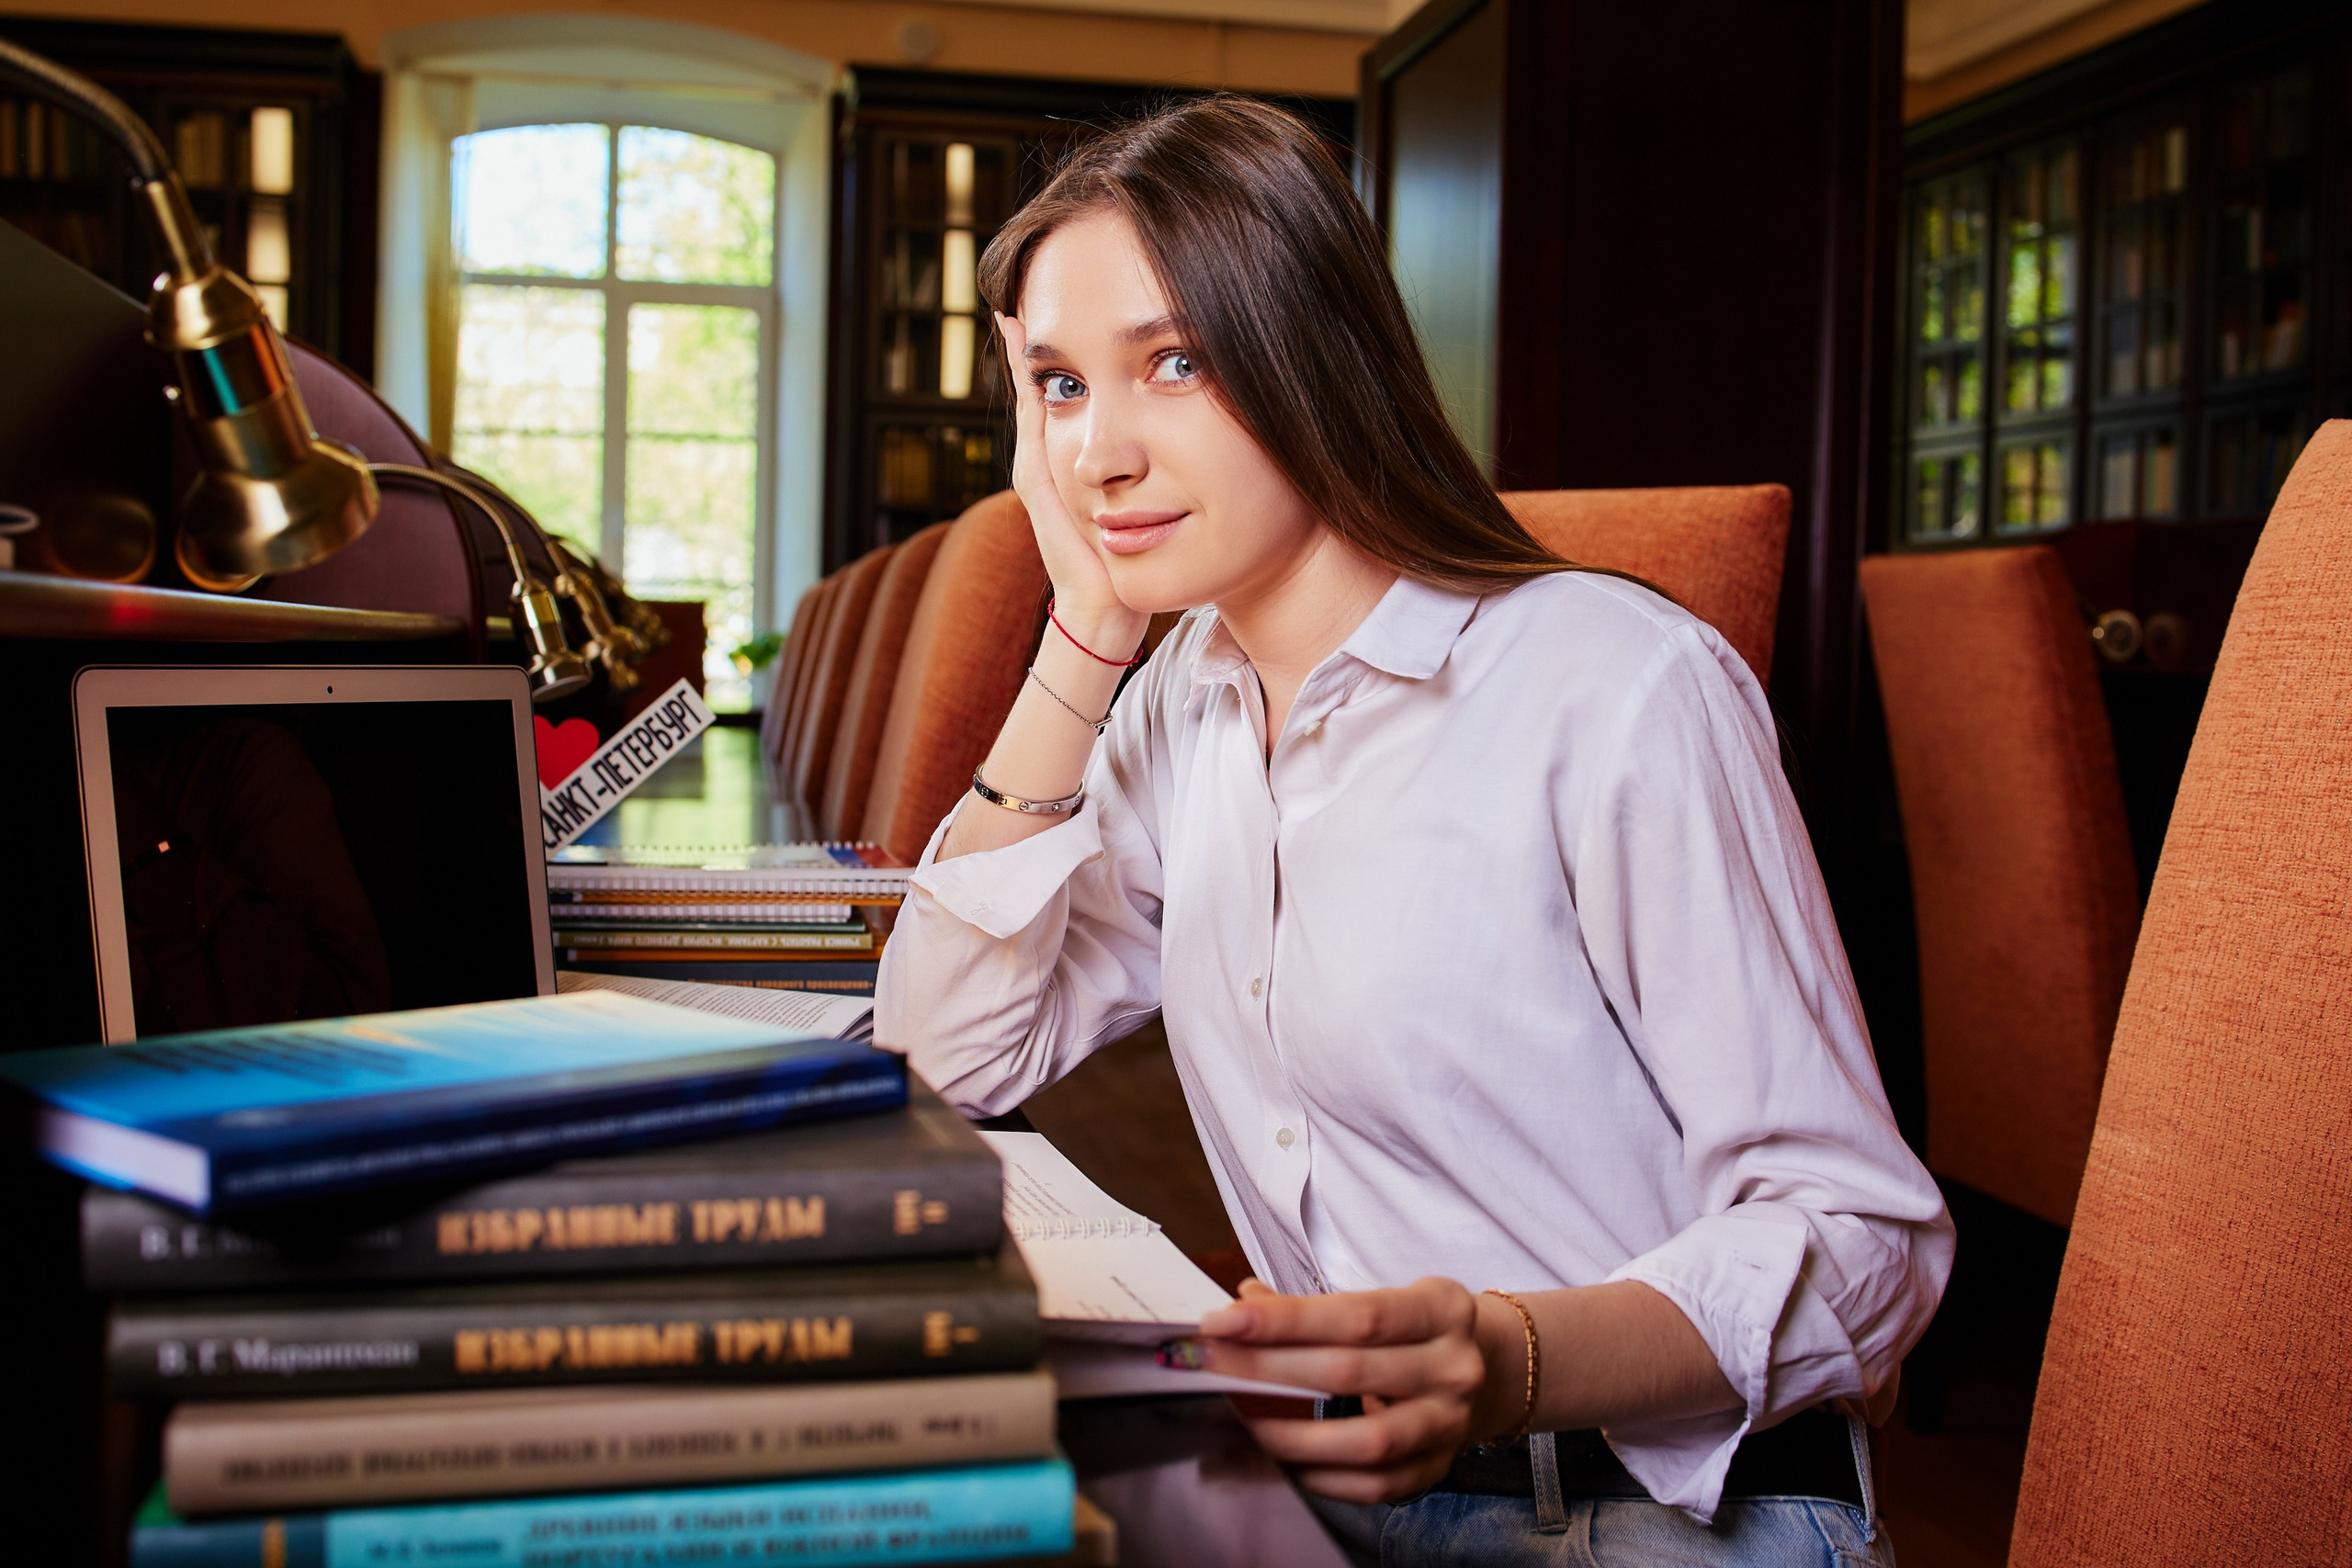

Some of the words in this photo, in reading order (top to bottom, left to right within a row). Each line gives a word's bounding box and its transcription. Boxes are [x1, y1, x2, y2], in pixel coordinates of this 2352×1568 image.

[683, 936, 722, 946] ИСТОРИЯ
[781, 937, 821, 947] РАБОТАТЬ
[825, 937, 861, 947] УЧИМСЯ
[437, 1202, 682, 1255] ИЗБРАННЫЕ
[691, 1195, 825, 1243] ТРУДЫ
[455, 1322, 702, 1373] ИЗБРАННЫЕ
[714, 1314, 853, 1366] ТРУДЫ
